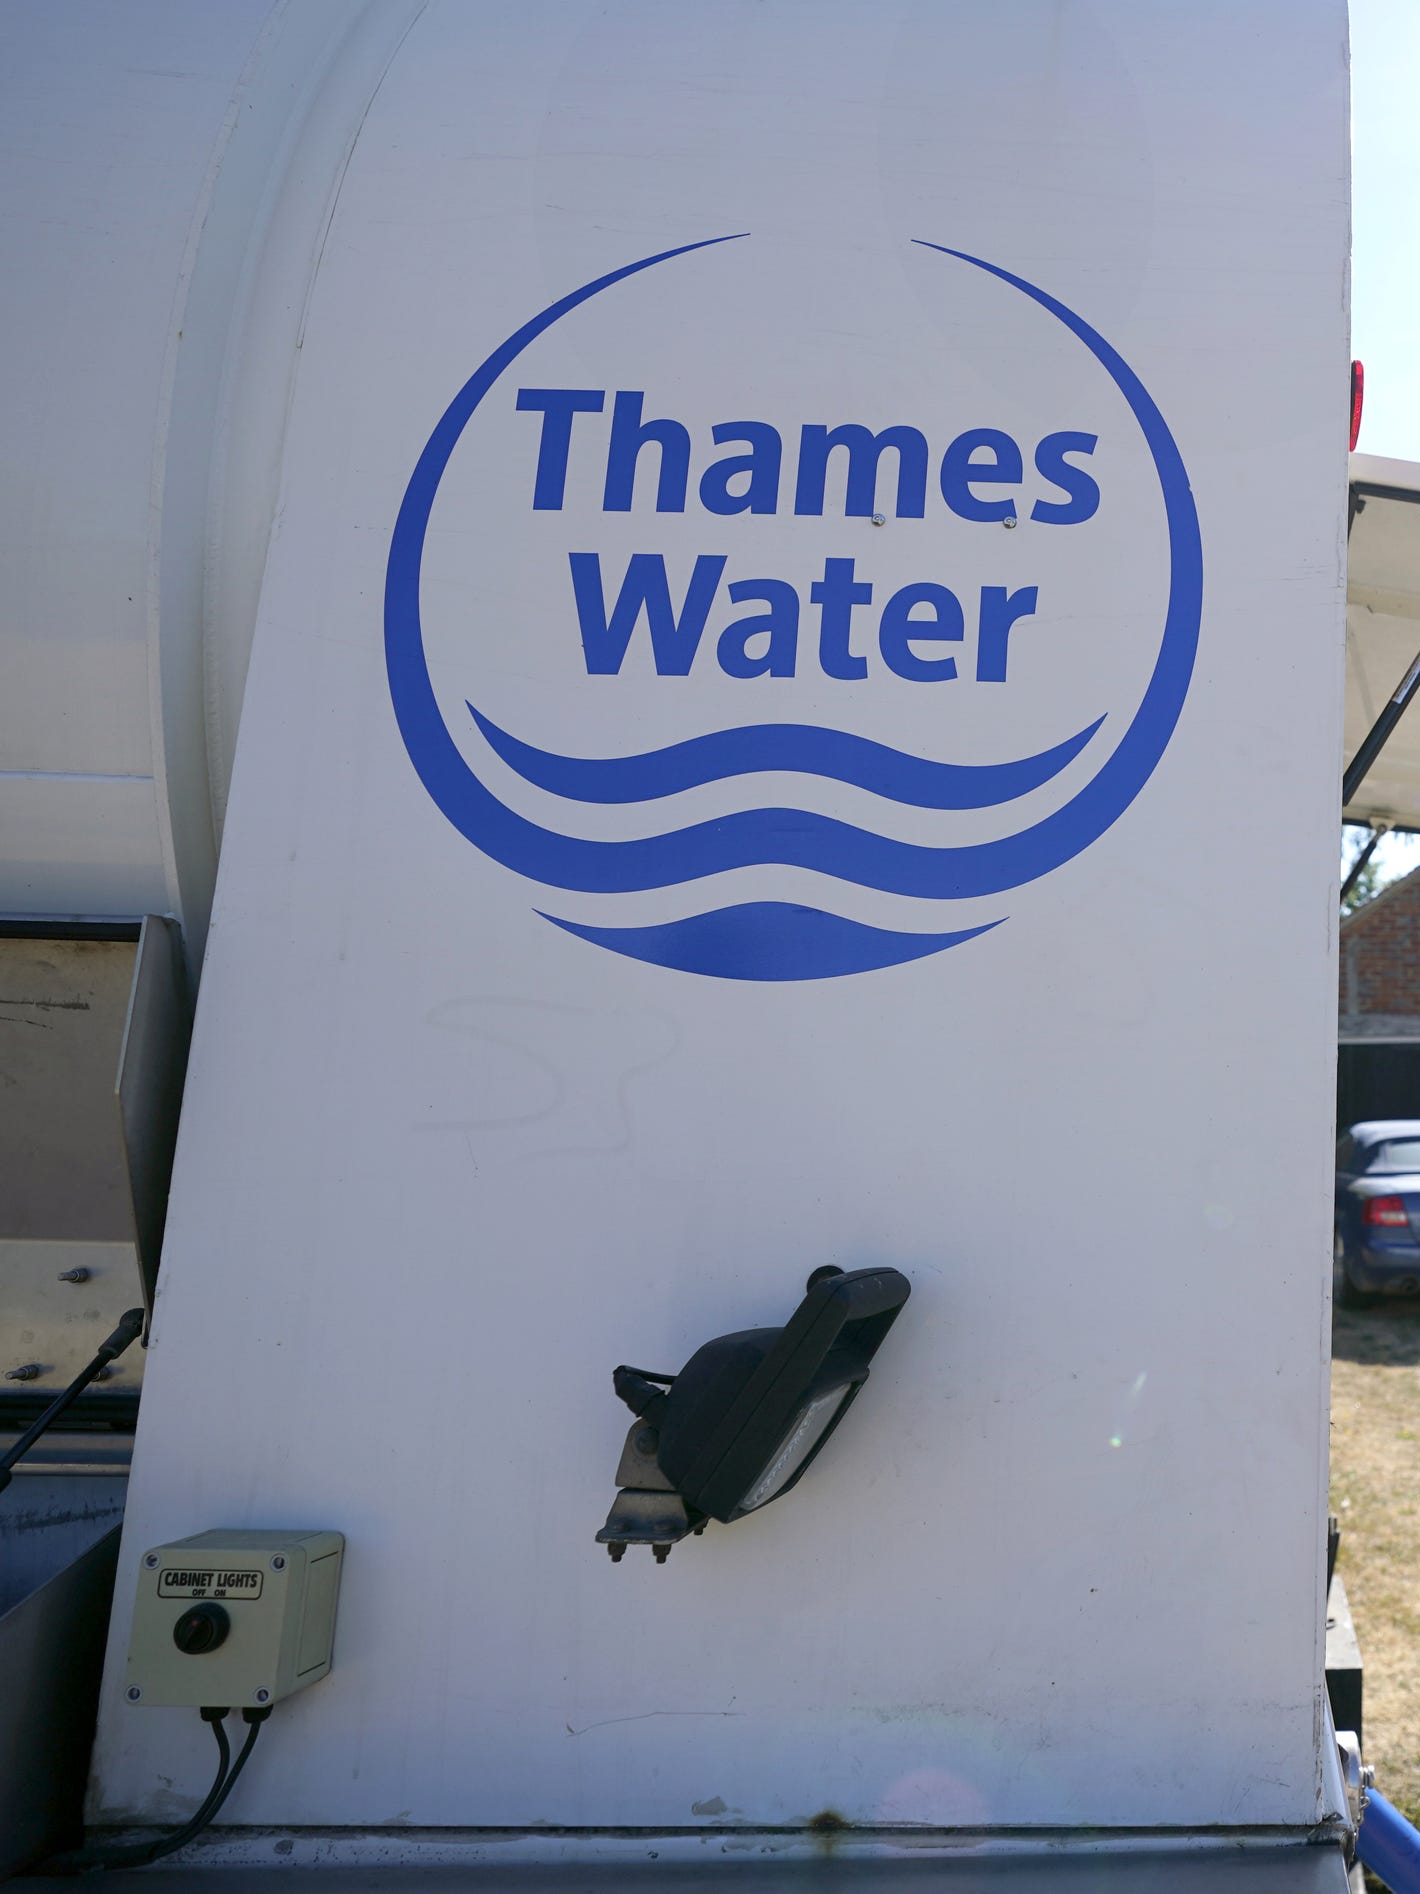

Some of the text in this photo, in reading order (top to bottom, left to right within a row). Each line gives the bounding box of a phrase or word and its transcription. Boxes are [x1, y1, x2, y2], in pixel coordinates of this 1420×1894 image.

[515, 388, 1102, 526] Thames
[569, 552, 1039, 683] Water
[164, 1572, 258, 1588] CABINET LIGHTS
[192, 1588, 226, 1597] OFF ON
